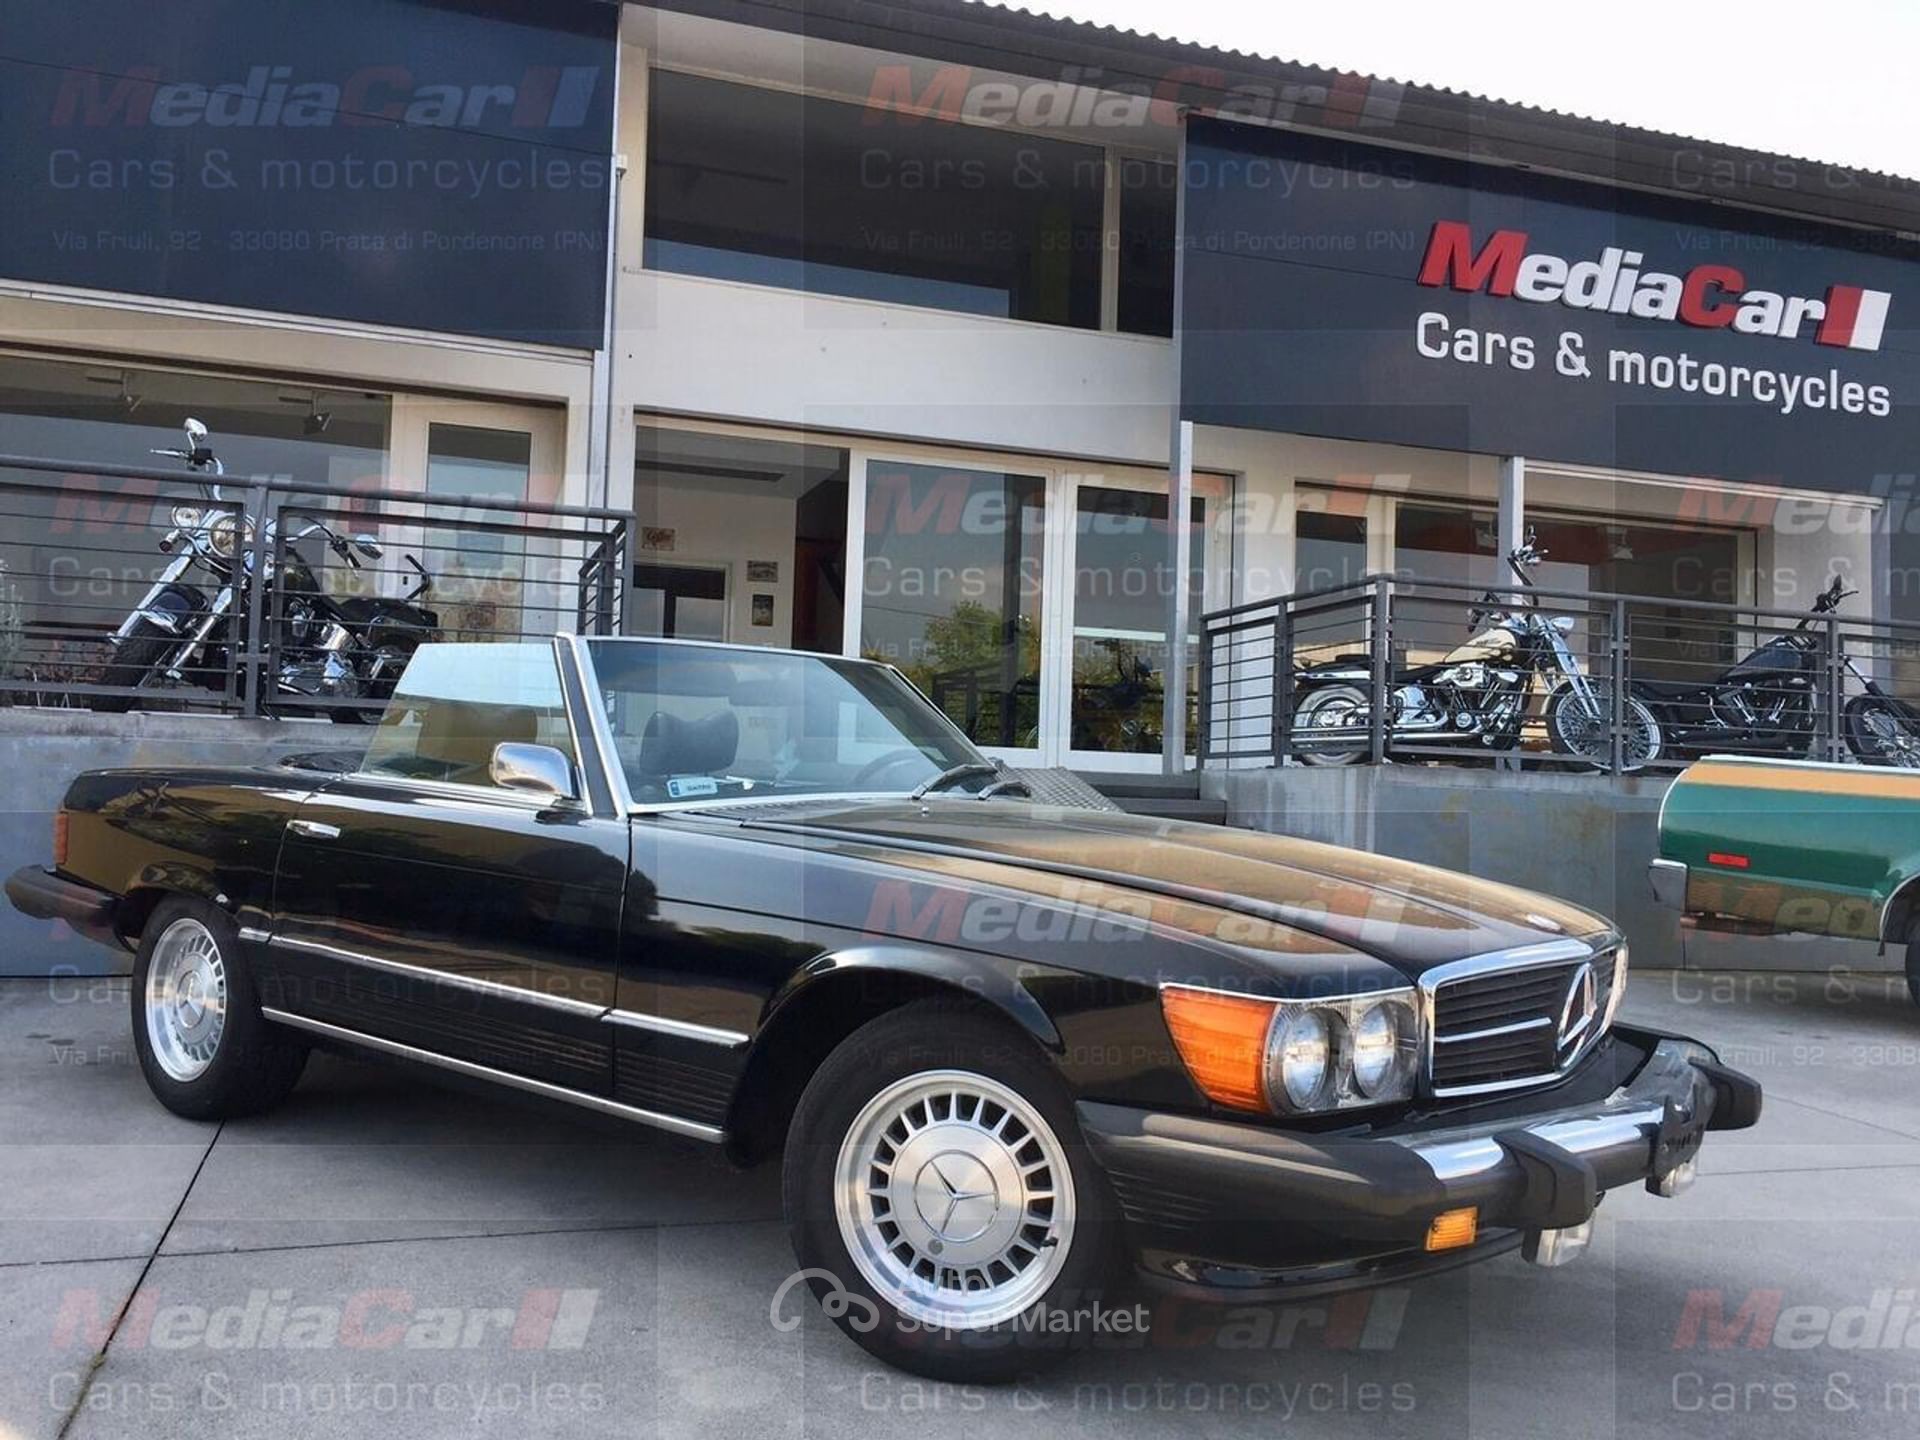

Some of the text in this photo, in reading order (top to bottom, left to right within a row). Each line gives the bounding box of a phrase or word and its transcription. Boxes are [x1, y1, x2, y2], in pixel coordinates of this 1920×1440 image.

[1417, 220, 1827, 339] MediaCar
[1416, 311, 1891, 417] Cars & motorcycles
